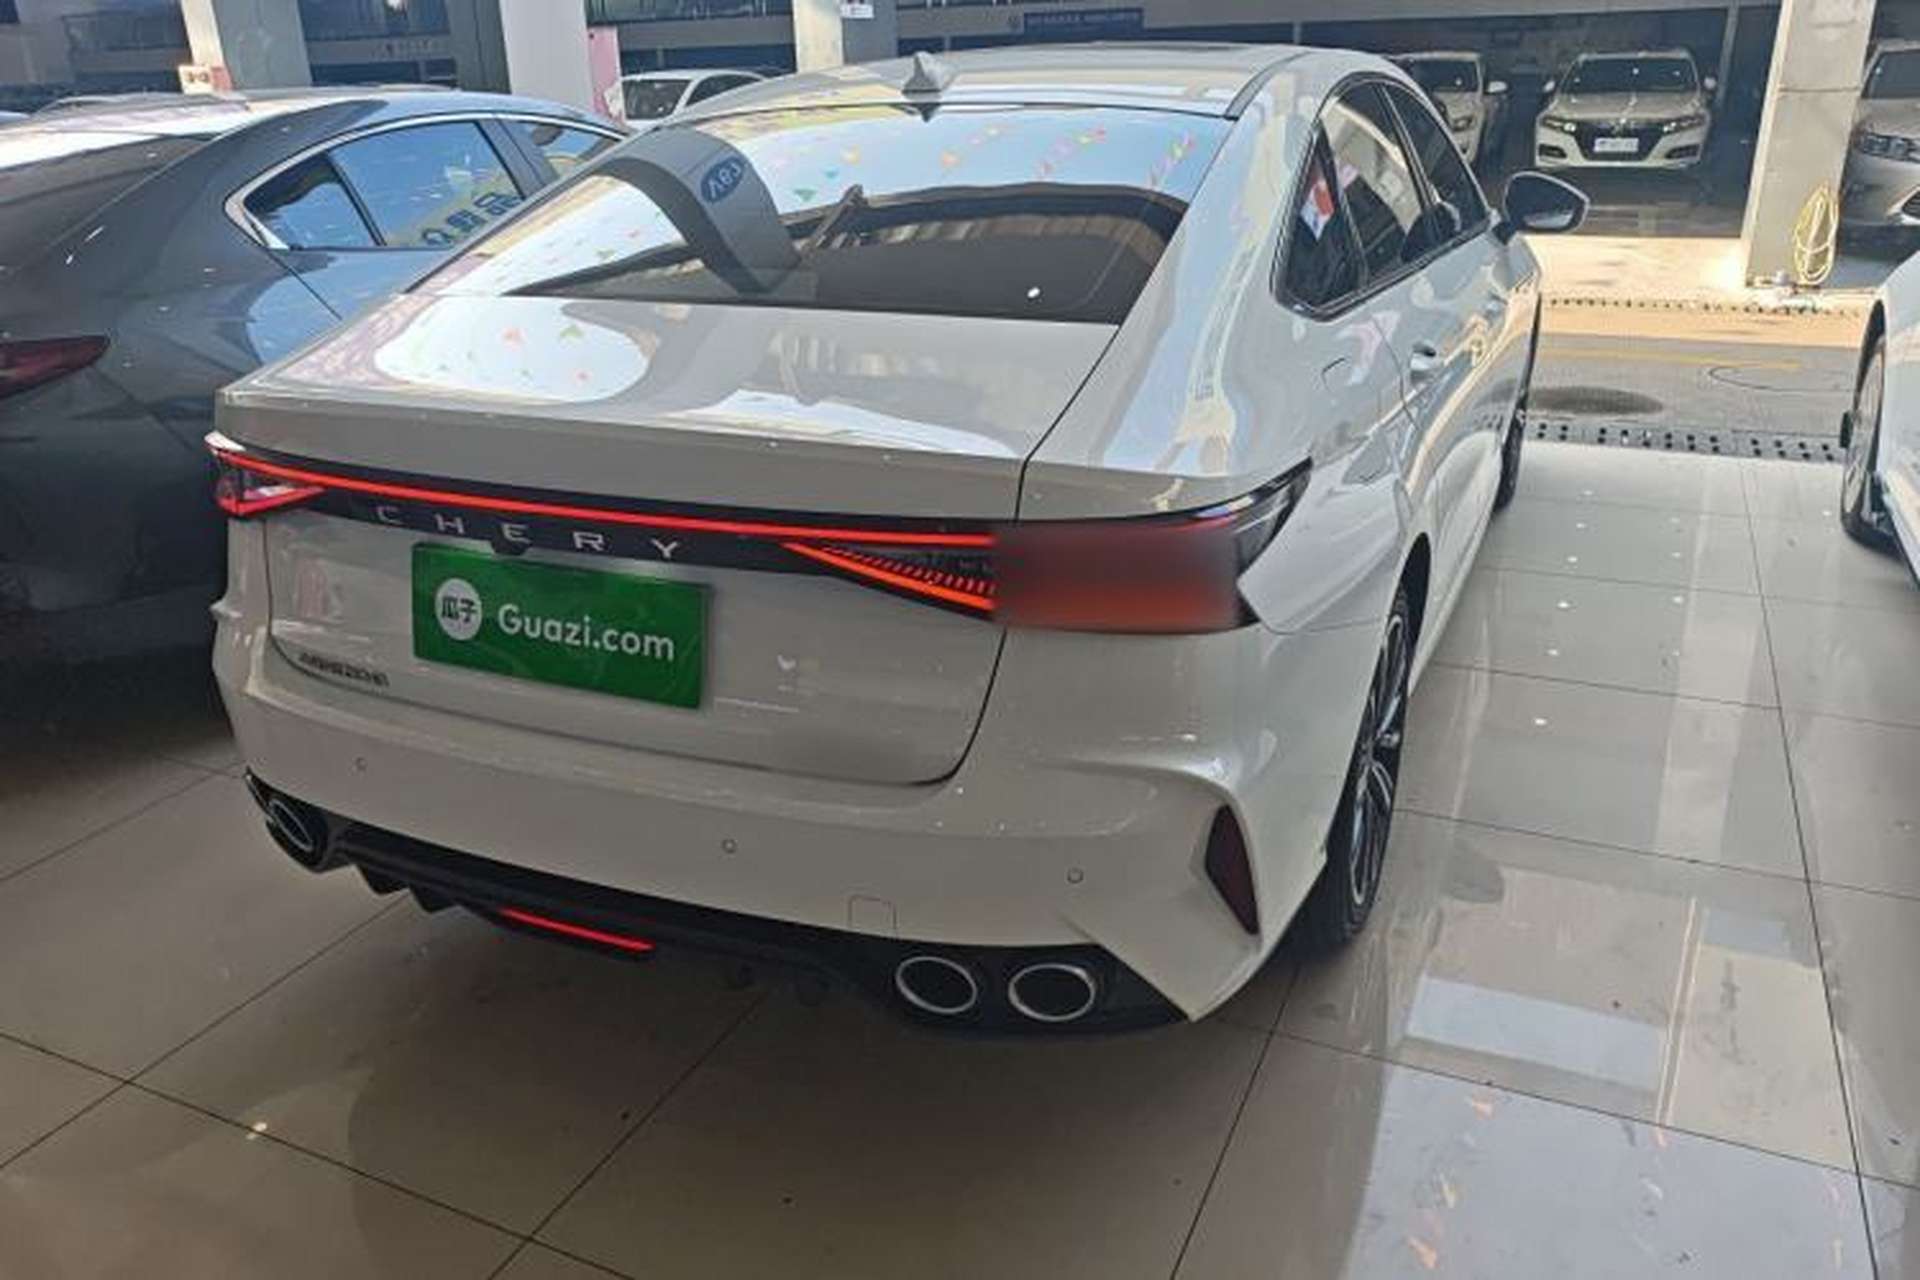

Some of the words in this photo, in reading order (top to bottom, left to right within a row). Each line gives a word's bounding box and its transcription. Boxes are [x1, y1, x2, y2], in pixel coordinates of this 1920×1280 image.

[376, 505, 679, 559] CHERY
[440, 595, 477, 623] 瓜子
[498, 603, 675, 661] Guazi.com
